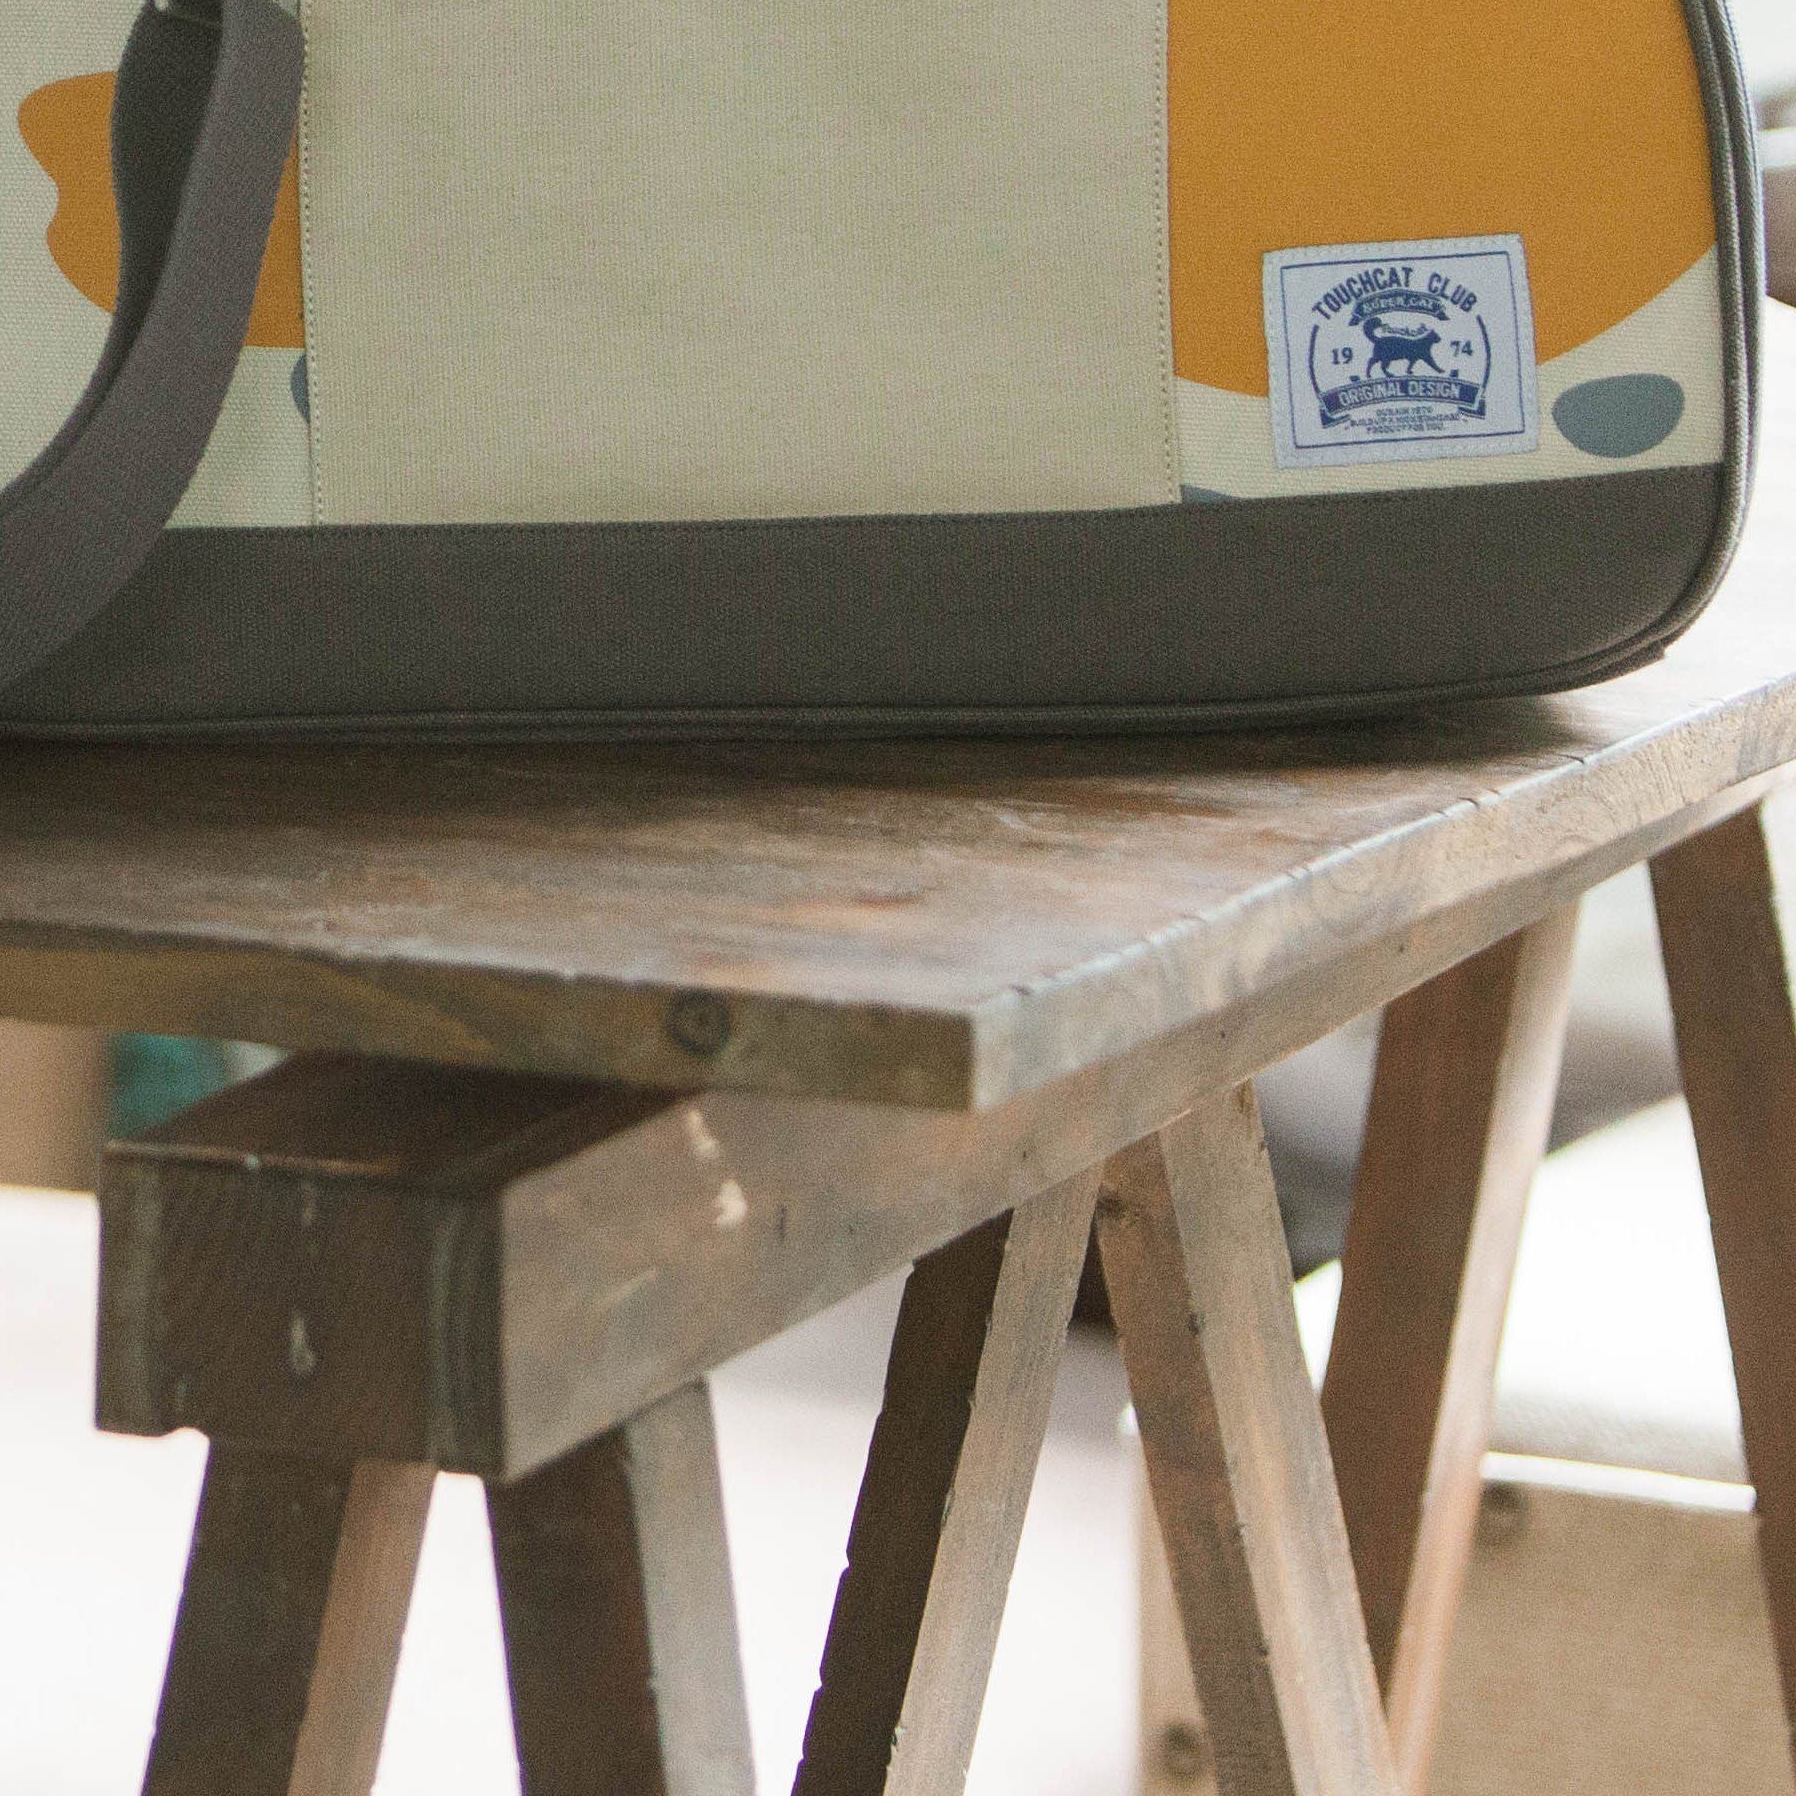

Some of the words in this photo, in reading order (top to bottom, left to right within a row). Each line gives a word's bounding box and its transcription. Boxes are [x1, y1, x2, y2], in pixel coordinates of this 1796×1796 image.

[1312, 266, 1414, 320] TOUCHCAT
[1427, 272, 1478, 313] CLUB
[1330, 346, 1354, 365] 19
[1449, 339, 1474, 357] 74
[1338, 379, 1404, 406] ORIGINAL
[1408, 378, 1461, 399] DESIGN
